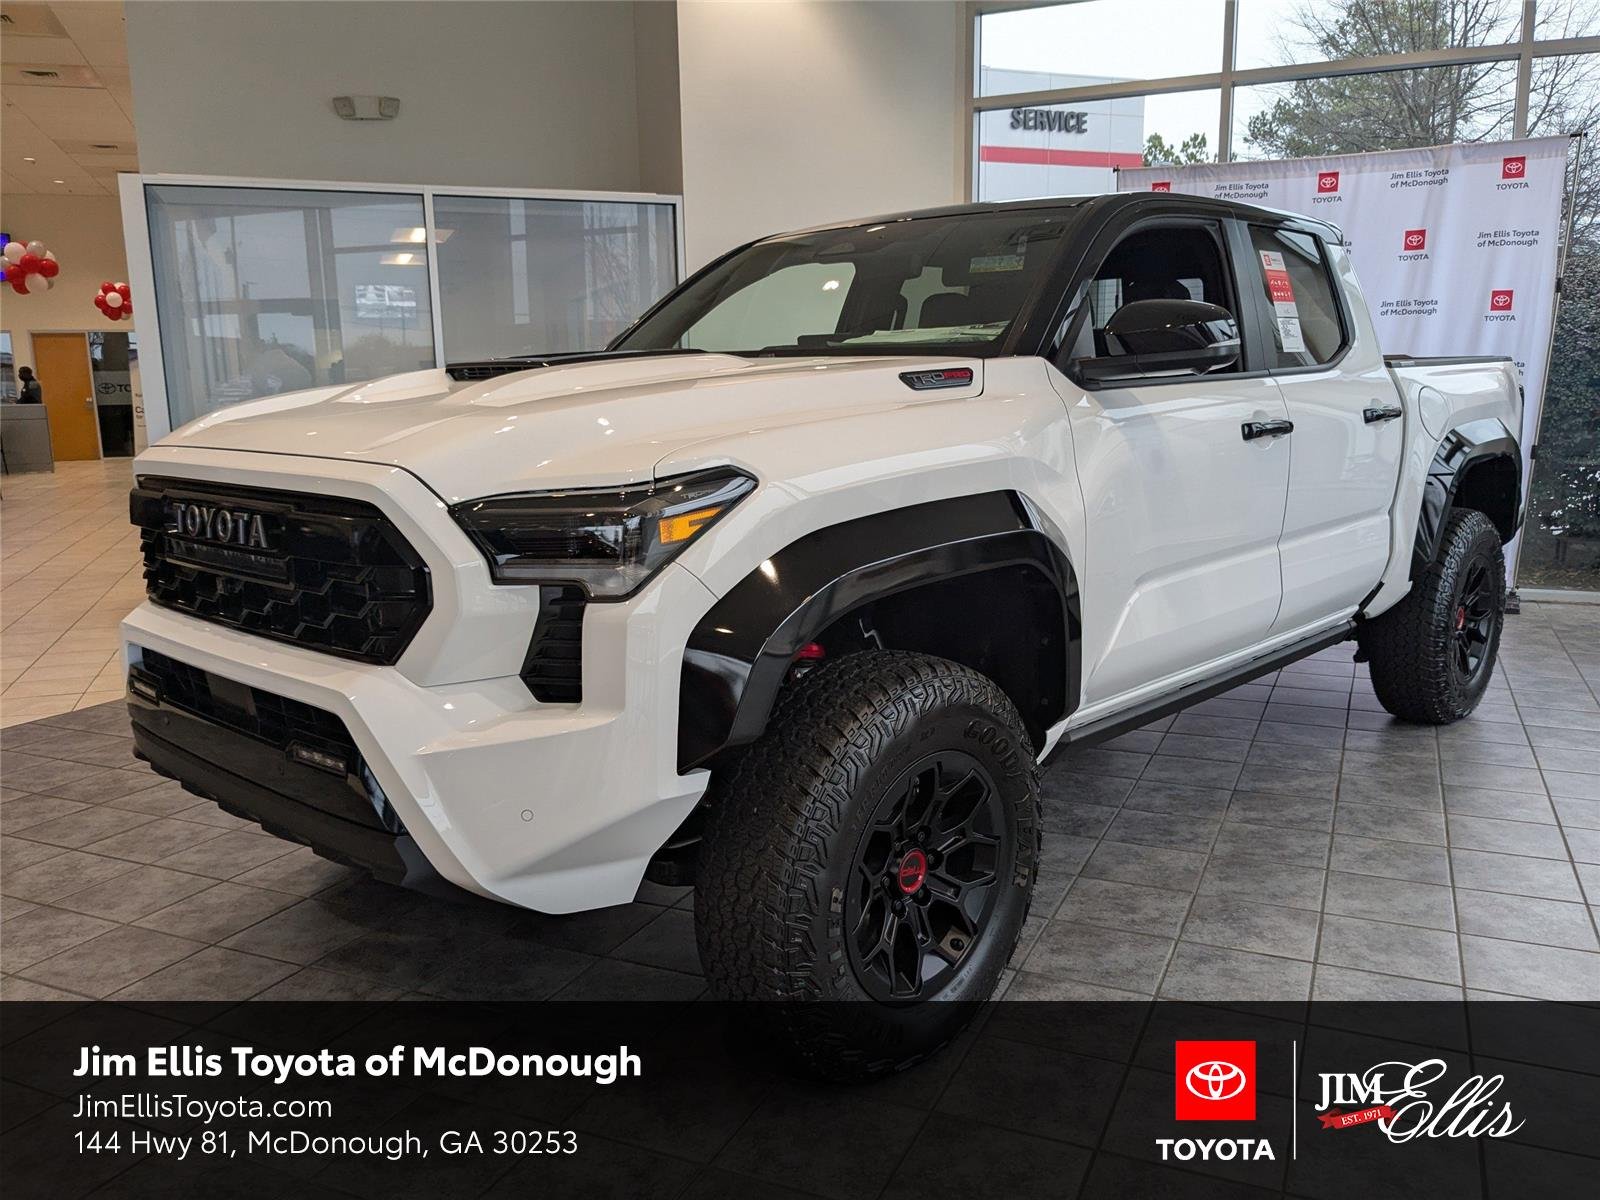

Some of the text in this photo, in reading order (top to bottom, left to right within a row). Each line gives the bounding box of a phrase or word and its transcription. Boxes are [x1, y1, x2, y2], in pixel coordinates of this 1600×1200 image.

[1010, 107, 1088, 134] SERVICE
[1390, 169, 1450, 180] Jim Ellis Toyota
[1228, 183, 1244, 191] Ellis
[1245, 182, 1269, 191] Toyota
[1390, 177, 1449, 189] of McDonough
[1496, 182, 1530, 191] TOYOTA
[1223, 190, 1268, 199] McDonough
[1312, 196, 1343, 204] TOYOTA
[1477, 229, 1540, 239] Jim Ellis Toyota
[1477, 239, 1538, 248] of McDonough
[1398, 253, 1429, 262] TOYOTA
[1380, 300, 1394, 308] Jim
[1413, 299, 1438, 308] Toyota
[1380, 307, 1437, 317] of McDonough
[1484, 314, 1516, 322] TOYOTA
[171, 502, 269, 548] TOYOTA
